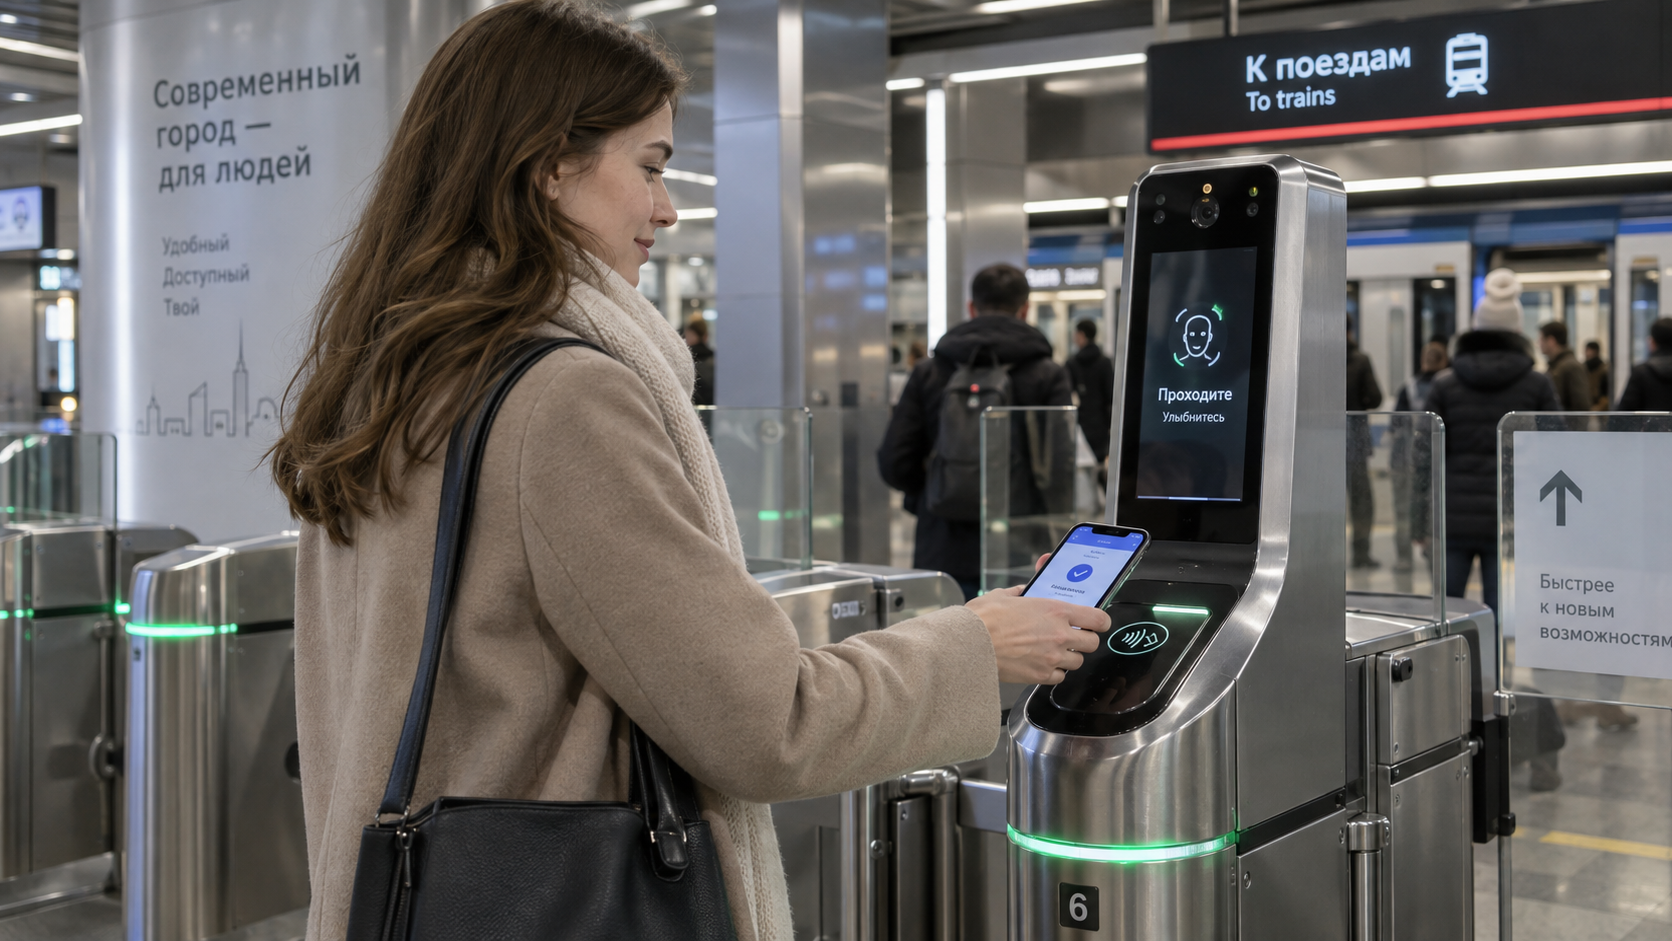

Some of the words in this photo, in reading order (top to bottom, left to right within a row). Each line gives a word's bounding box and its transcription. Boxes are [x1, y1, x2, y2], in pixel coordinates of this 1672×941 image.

[1246, 55, 1268, 83] К
[1275, 46, 1411, 81] поездам
[153, 53, 361, 110] Современный
[1245, 90, 1272, 112] To
[1276, 86, 1337, 110] trains
[156, 119, 236, 152] город
[158, 163, 206, 194] для
[215, 146, 312, 186] людей
[161, 234, 230, 257] Удобный
[162, 264, 250, 289] Доступный
[164, 297, 200, 317] Твой
[1158, 387, 1233, 405] Проходите
[1162, 411, 1225, 424] Улыбнитесь
[1540, 573, 1615, 595] Быстрее
[1540, 602, 1550, 615] к
[1555, 602, 1615, 619] новым
[1540, 627, 1672, 649] возможностям
[1069, 892, 1088, 922] 6
